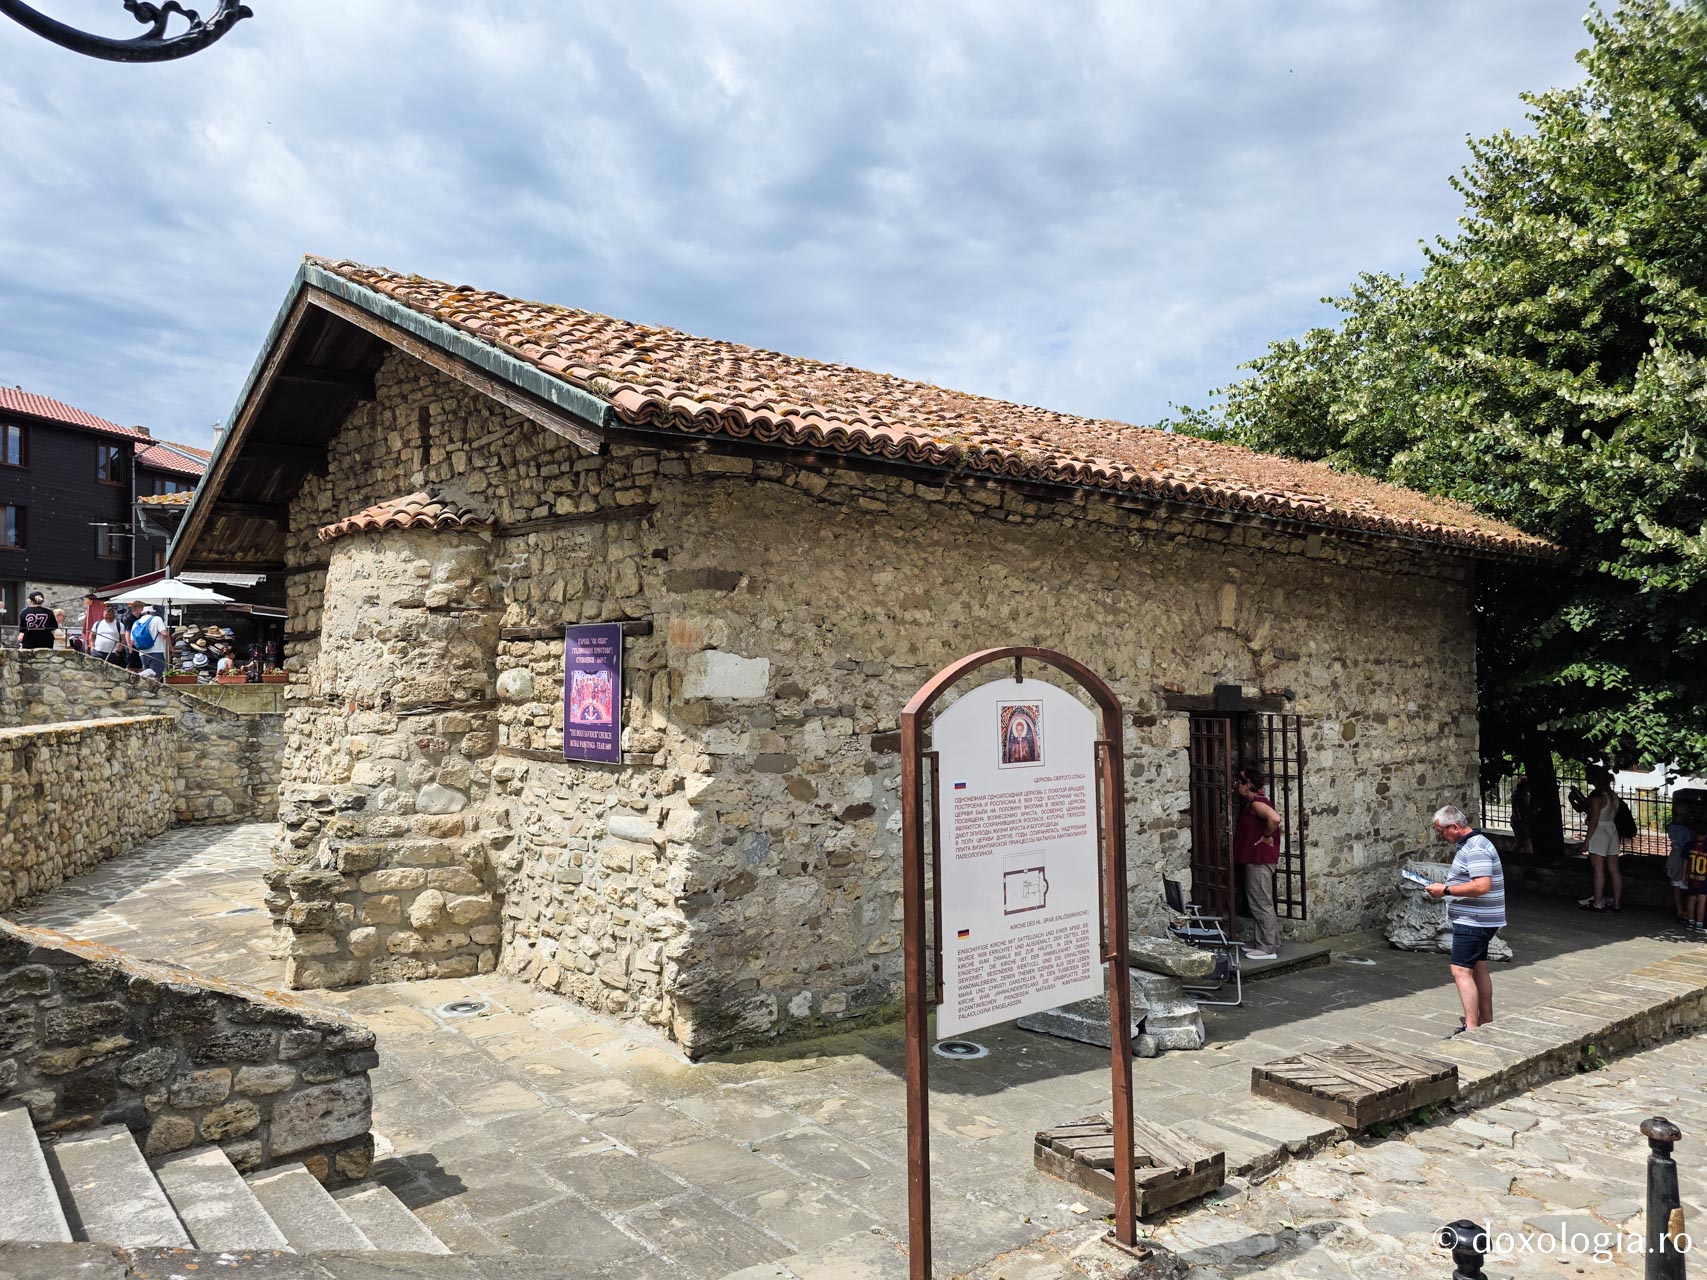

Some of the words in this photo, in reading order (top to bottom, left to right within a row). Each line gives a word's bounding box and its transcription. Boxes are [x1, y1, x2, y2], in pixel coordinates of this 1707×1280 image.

[26, 614, 48, 630] 27
[1690, 854, 1706, 874] 10
[958, 944, 988, 955] EINSCHIFFIGE
[958, 954, 974, 962] WURDE
[958, 961, 974, 969] KIRCHE
[994, 954, 1011, 962] DAMALS
[958, 997, 975, 1005] KIRCHE
